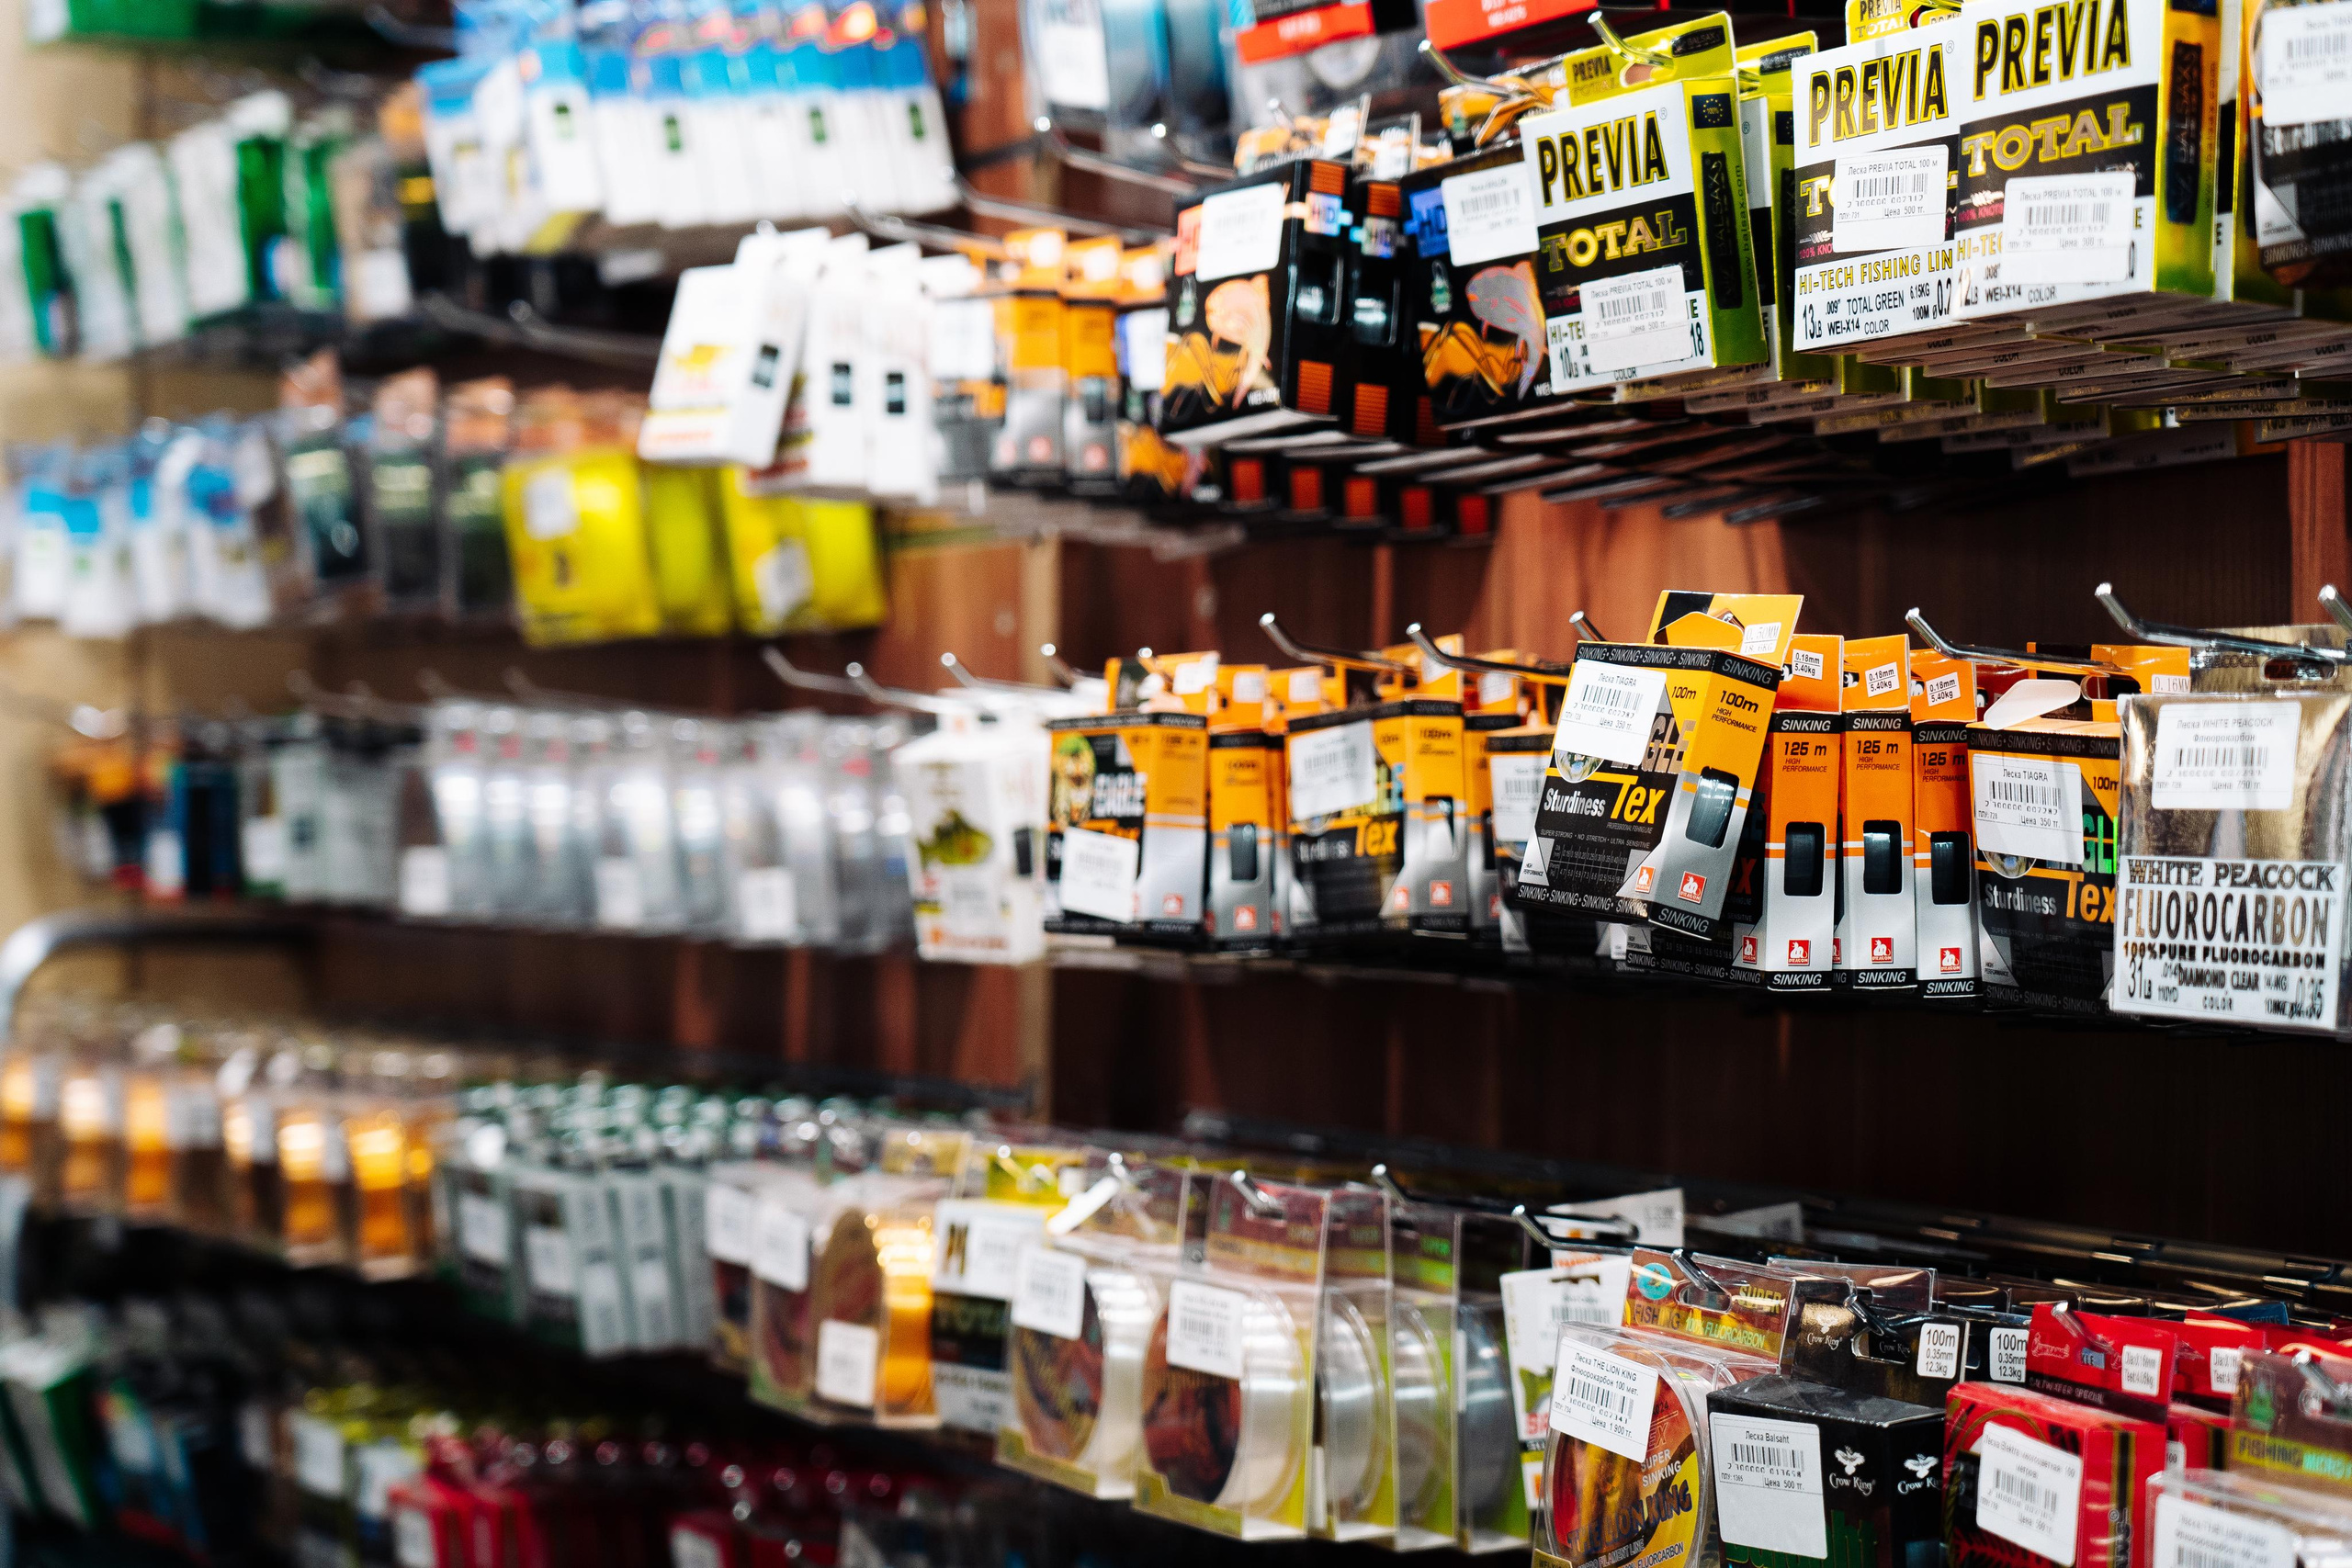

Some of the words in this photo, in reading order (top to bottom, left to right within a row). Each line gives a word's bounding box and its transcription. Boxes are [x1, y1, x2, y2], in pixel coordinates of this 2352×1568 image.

[1856, 17, 1907, 38] TOTAL
[1973, 0, 2131, 102] PREVIA
[1573, 55, 1611, 83] PREVIA
[1809, 43, 1949, 148] PREVIA
[1962, 101, 2144, 177] TOTAL
[1536, 110, 1669, 207] PREVIA
[1848, 164, 1867, 175] Леска
[1869, 163, 1893, 173] PREVIA
[1894, 160, 1917, 170] TOTAL
[1919, 159, 1930, 167] 100
[1884, 207, 1901, 217] Цена
[1904, 206, 1916, 215] 500
[1540, 210, 1687, 272] TOTAL
[1799, 265, 1853, 295] HI-TECH
[1860, 254, 1920, 284] FISHING
[1609, 285, 1632, 295] PREVIA
[1633, 281, 1653, 290] TOTAL
[1655, 279, 1666, 288] 100
[1985, 285, 2021, 303] WEI-X14
[2028, 287, 2057, 303] COLOR
[1847, 296, 1873, 315] TOTAL
[1875, 290, 1905, 311] GREEN
[1910, 283, 1930, 299] 6.15KG
[1648, 322, 1658, 331] 500
[1827, 318, 1860, 336] WEI-X14
[1864, 321, 1890, 334] COLOR
[1912, 306, 1929, 321] 100M
[1613, 367, 1637, 380] COLOR
[1577, 646, 1607, 660] SINKING
[1610, 648, 1640, 661] SINKING
[1643, 650, 1673, 665] SINKING
[1679, 652, 1712, 667] SINKING
[1795, 652, 1820, 665] 0.18mm
[1722, 659, 1773, 685] SINKING
[1794, 664, 1815, 676] 5.40kg
[1869, 668, 1894, 682] 0.18mm
[1616, 675, 1636, 686] TIAGRA
[1870, 681, 1893, 693] 5.40kg
[1928, 678, 1956, 693] 0.18mm
[1672, 685, 1697, 700] 100m
[1719, 690, 1759, 714] 100m
[1930, 690, 1954, 703] 5.40kg
[1716, 707, 1732, 716] HIGH
[1615, 720, 1625, 729] 350
[1712, 714, 1758, 733] PERFORMANCE
[1781, 719, 1832, 731] SINKING
[1852, 717, 1902, 729] SINKING
[2232, 717, 2273, 728] PEACOCK
[1918, 730, 1968, 742] SINKING
[1970, 734, 2003, 748] SINKING
[2007, 737, 2045, 750] SINKING
[2046, 739, 2081, 753] SINKING
[1783, 741, 1809, 756] 125
[1814, 743, 1827, 756] m
[1856, 740, 1882, 754] 125
[1886, 741, 1899, 754] m
[1921, 751, 1948, 766] 125
[1952, 754, 1966, 765] m
[2003, 769, 2021, 778] Леска
[2023, 771, 2048, 782] TIAGRA
[1544, 787, 1606, 818] Sturdiness
[1611, 775, 1666, 824] Tex
[1990, 812, 1998, 820] 728
[2021, 815, 2037, 825] Цена
[2040, 818, 2051, 827] 350
[1354, 818, 1398, 858] Tex
[1555, 830, 1573, 839] STRONG
[1586, 834, 1607, 843] STRETCH
[1626, 840, 1650, 849] SENSITIVE
[2127, 859, 2203, 886] WHITE
[2213, 862, 2336, 892] PEACOCK
[1518, 885, 1546, 901] SINKING
[1549, 890, 1577, 906] SINKING
[1581, 896, 1611, 911] SINKING
[1985, 883, 2057, 916] Sturdiness
[1658, 908, 1710, 933] SINKING
[2123, 887, 2329, 948] FLUOROCARBON
[2123, 941, 2157, 960] 100%
[2160, 942, 2196, 962] PURE
[2203, 945, 2325, 970] FLUOROCARBON
[1627, 953, 1656, 968] SINKING
[1659, 958, 1690, 974] SINKING
[1694, 964, 1724, 979] SINKING
[1729, 969, 1761, 985] SINKING
[1857, 971, 1907, 983] SINKING
[1984, 968, 2009, 977] PERFORMANCE
[1772, 974, 1823, 986] SINKING
[1926, 980, 1975, 994] SINKING
[2231, 970, 2260, 992] CLEAR
[1986, 985, 2019, 1002] SINKING
[2024, 992, 2057, 1007] SINKING
[2063, 997, 2097, 1013] SINKING
[2202, 997, 2233, 1010] COLOR
[1738, 1285, 1782, 1314] SUPER
[1926, 1329, 1956, 1348] 100m
[1926, 1348, 1953, 1360] 0.35mm
[1575, 1352, 1592, 1366] Леска
[1593, 1359, 1605, 1371] THE
[1606, 1363, 1621, 1375] LION
[1622, 1370, 1637, 1382] KING
[1925, 1362, 1949, 1375] 12.3kg
[1998, 1365, 2021, 1380] 12.3kg
[1571, 1364, 1614, 1386] Флюорокарбон
[1615, 1381, 1625, 1392] 100
[1626, 1386, 1639, 1396] мет.
[1591, 1416, 1606, 1428] Цена
[1614, 1425, 1624, 1435] 900
[1746, 1430, 1764, 1442] Леска
[1766, 1433, 1790, 1444] Balsaht
[1641, 1449, 1671, 1472] SUPER
[1642, 1460, 1682, 1487] SINKING
[1764, 1477, 1781, 1488] Цена
[1783, 1480, 1795, 1489] 500
[1828, 1472, 1851, 1489] Crow
[1852, 1477, 1873, 1496] King
[1897, 1480, 1923, 1495] Crow
[1645, 1479, 1692, 1524] KING
[1637, 1541, 1684, 1568] FLUORCARBON
